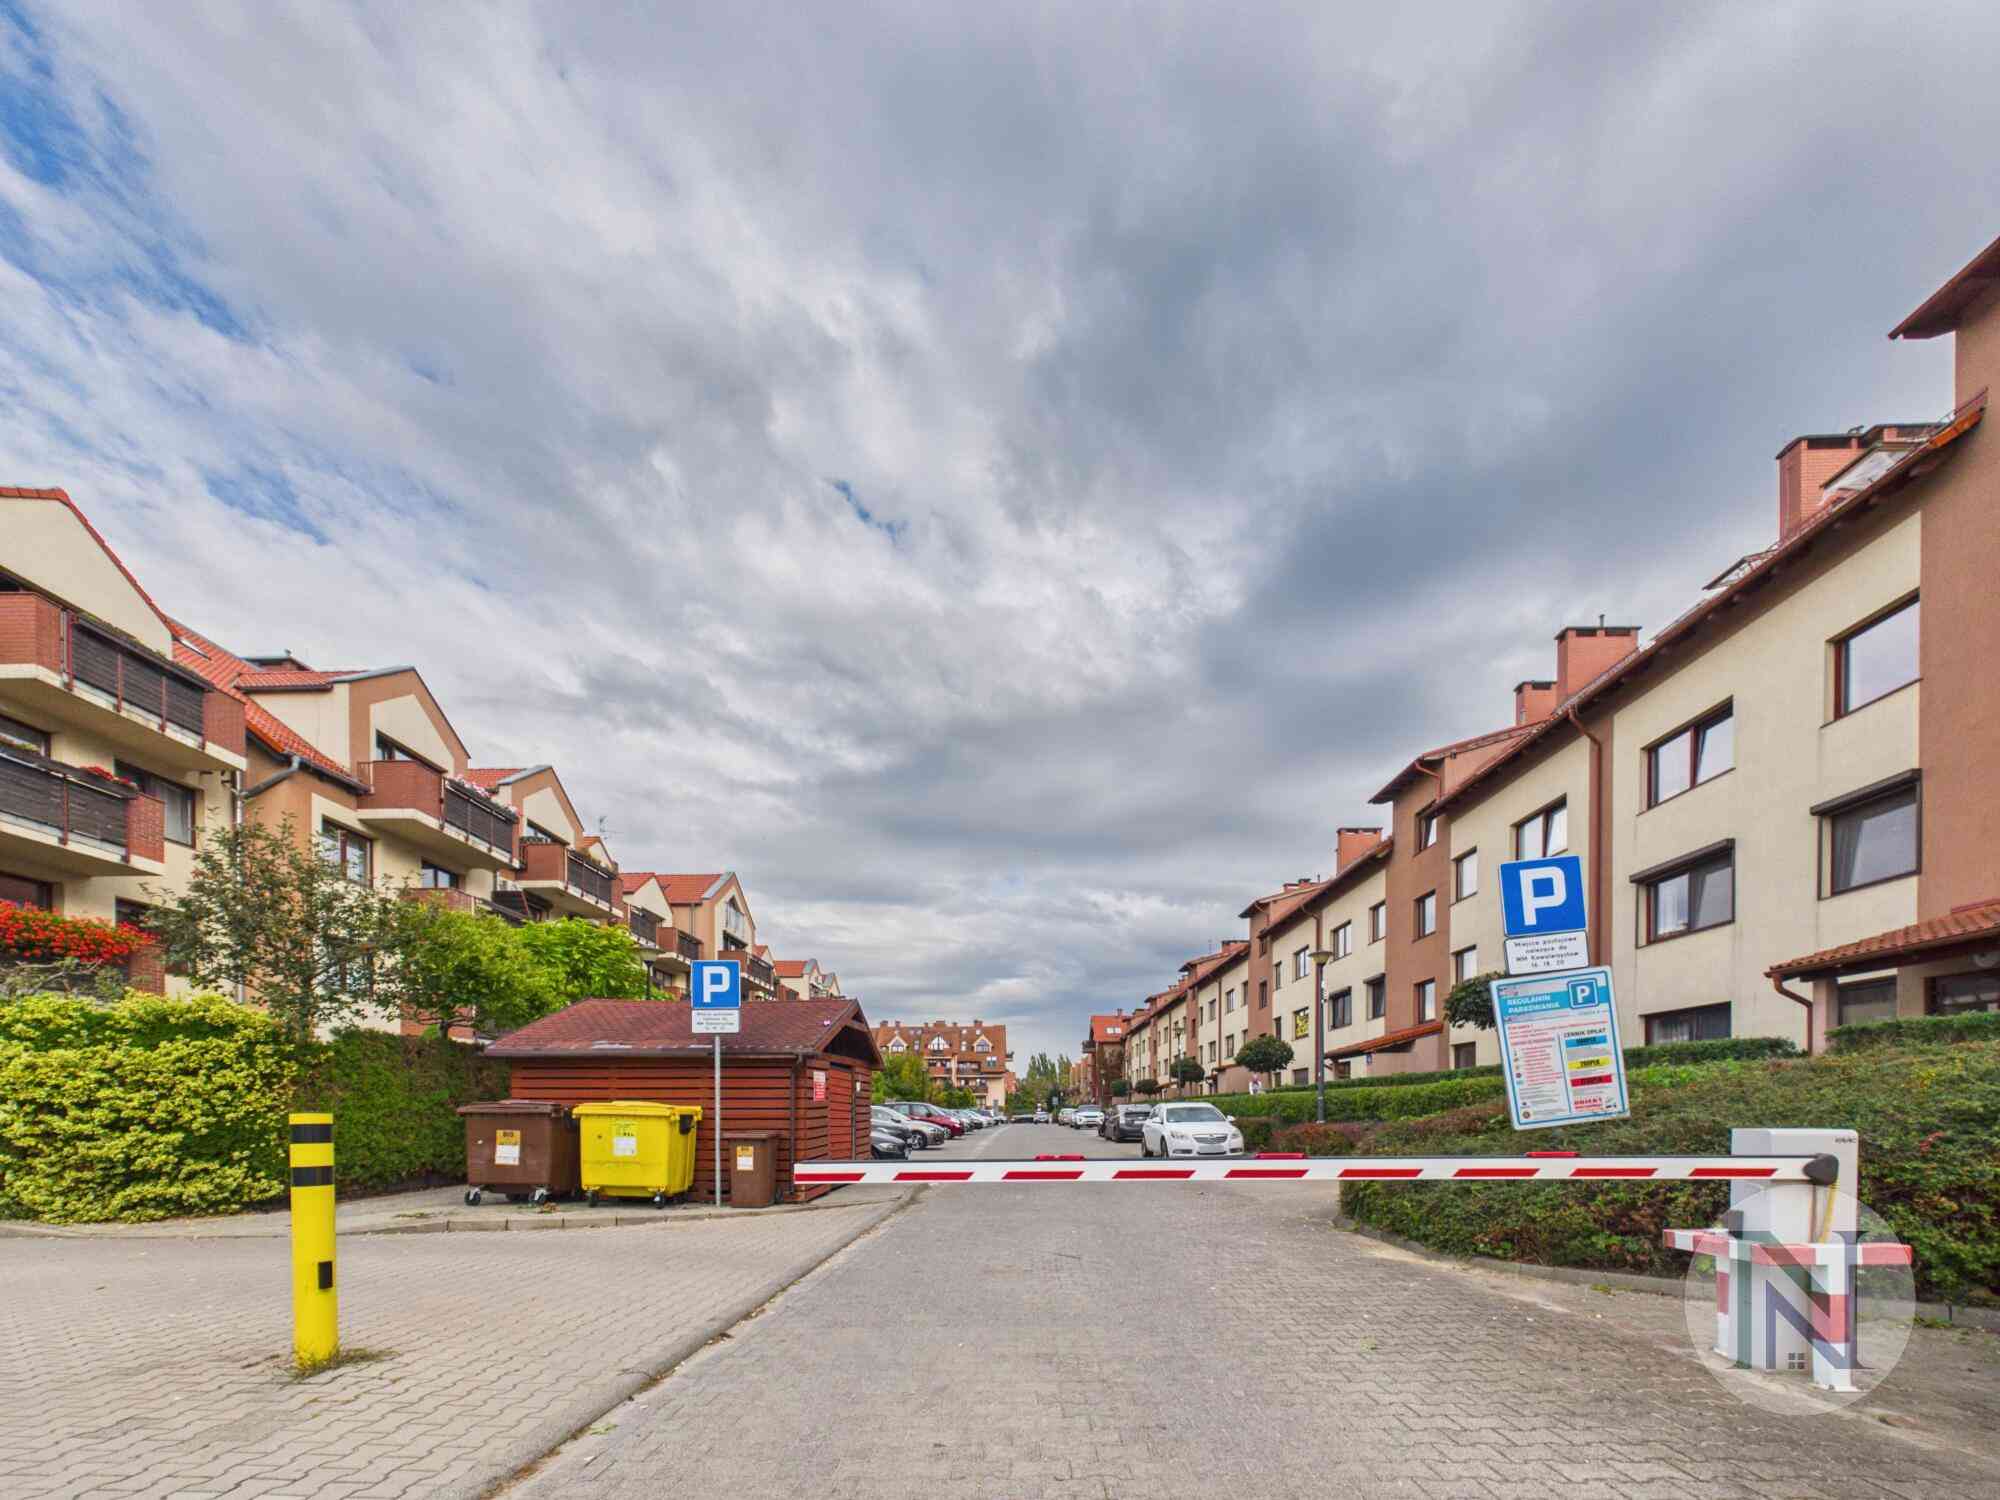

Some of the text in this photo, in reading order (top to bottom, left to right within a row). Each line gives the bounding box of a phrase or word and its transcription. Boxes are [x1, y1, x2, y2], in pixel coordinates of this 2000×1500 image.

[1519, 866, 1567, 926] P
[702, 965, 730, 1003] P
[1576, 985, 1590, 1003] P
